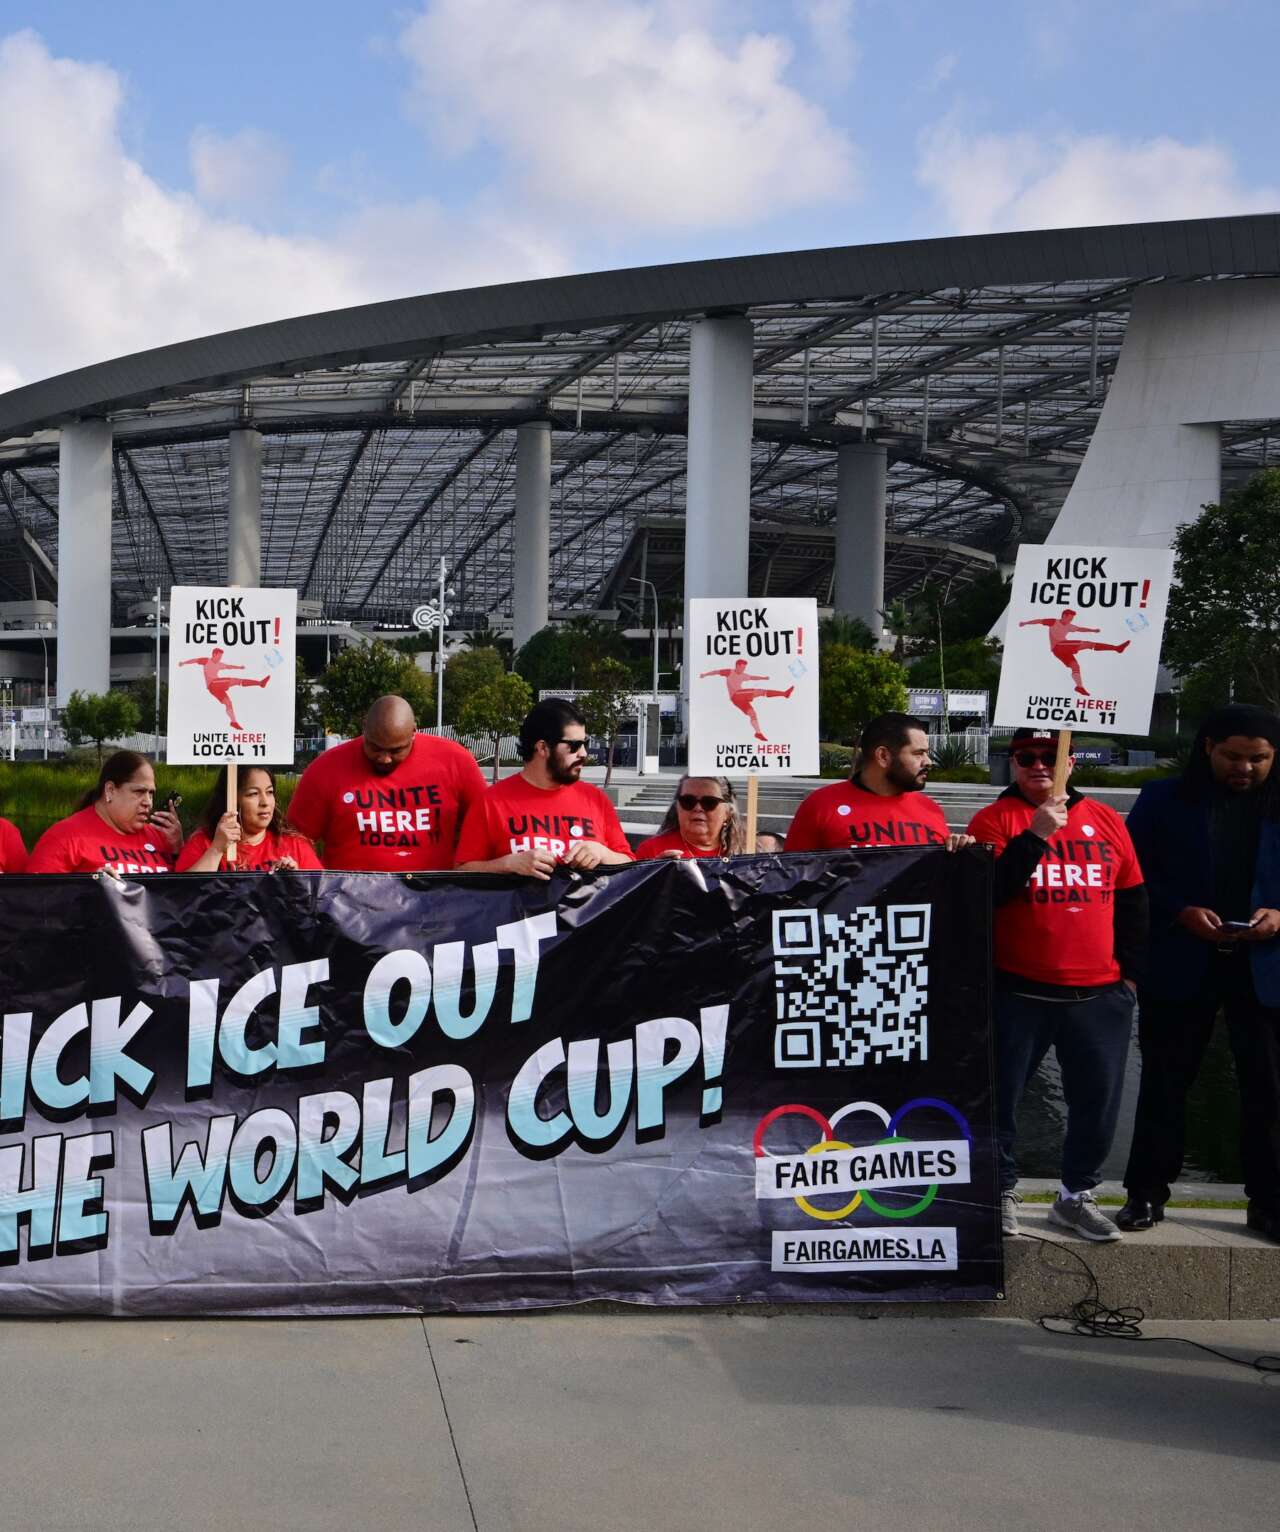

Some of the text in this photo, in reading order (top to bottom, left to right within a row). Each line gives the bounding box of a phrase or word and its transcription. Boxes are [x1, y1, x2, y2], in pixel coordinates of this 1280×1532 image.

[1046, 557, 1108, 580] KICK
[1030, 582, 1072, 605] ICE
[196, 597, 245, 620] KICK
[716, 607, 769, 632] KICK
[185, 623, 218, 644] ICE
[706, 634, 741, 656] ICE
[1028, 695, 1118, 711] UNITE HERE!
[1026, 707, 1116, 725] LOCAL 11
[193, 733, 266, 743] UNITE HERE!
[716, 744, 791, 754] UNITE HERE!
[193, 744, 266, 757] LOCAL 11
[716, 755, 791, 768] LOCAL 11
[355, 785, 441, 809] UNITE
[508, 815, 596, 838] UNITE
[360, 832, 420, 847] LOCAL
[1044, 840, 1113, 862] NITE
[186, 958, 330, 1095] ICE
[363, 911, 557, 1048] OUT
[141, 1064, 476, 1235] WORLD
[505, 1004, 730, 1160] CUP!
[775, 1150, 957, 1189] FAIR GAMES
[783, 1238, 946, 1262] FAIRGAMES.LA
